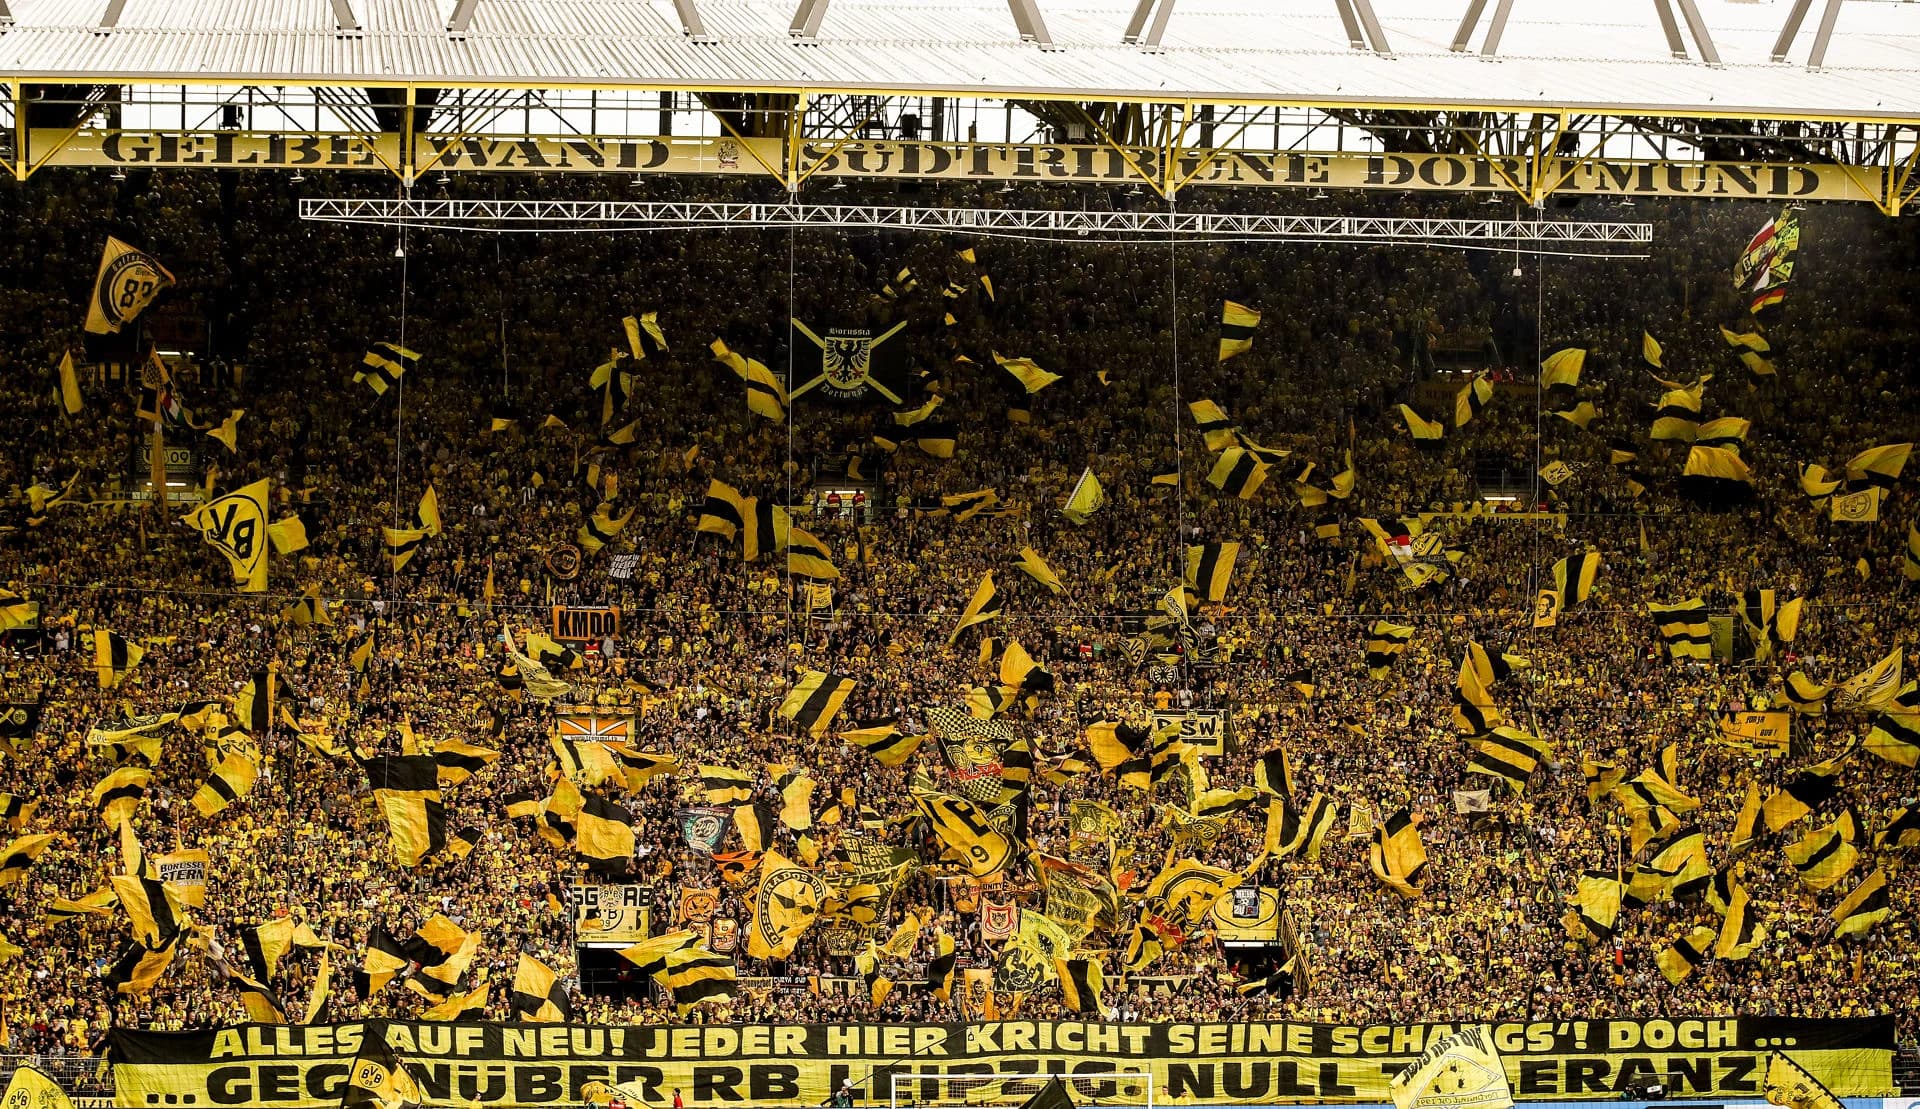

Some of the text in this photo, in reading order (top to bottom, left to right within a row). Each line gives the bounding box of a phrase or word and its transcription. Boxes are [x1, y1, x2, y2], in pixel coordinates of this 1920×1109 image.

[101, 132, 1820, 196] GELBE WAND SÜDTRIBÜNE DORTMUND
[820, 383, 869, 399] Dortmund
[559, 611, 616, 637] KMDO
[160, 869, 205, 883] STERN
[210, 1024, 364, 1058] ALLES
[385, 1023, 483, 1056] AUF
[502, 1025, 625, 1057] NEU!
[645, 1026, 809, 1058] JEDER
[827, 1026, 948, 1056] HIER
[966, 1021, 1151, 1056] KRICHT
[1168, 1023, 1313, 1055] SEINE
[1331, 1021, 1589, 1055] SCHAGS'!
[1608, 1020, 1738, 1048] DOCH
[206, 1061, 666, 1104] GEGNÜBER
[693, 1063, 800, 1101] RB
[1165, 1061, 1356, 1099] NULL
[361, 1065, 382, 1084] BVB
[10, 1090, 28, 1106] BVB
